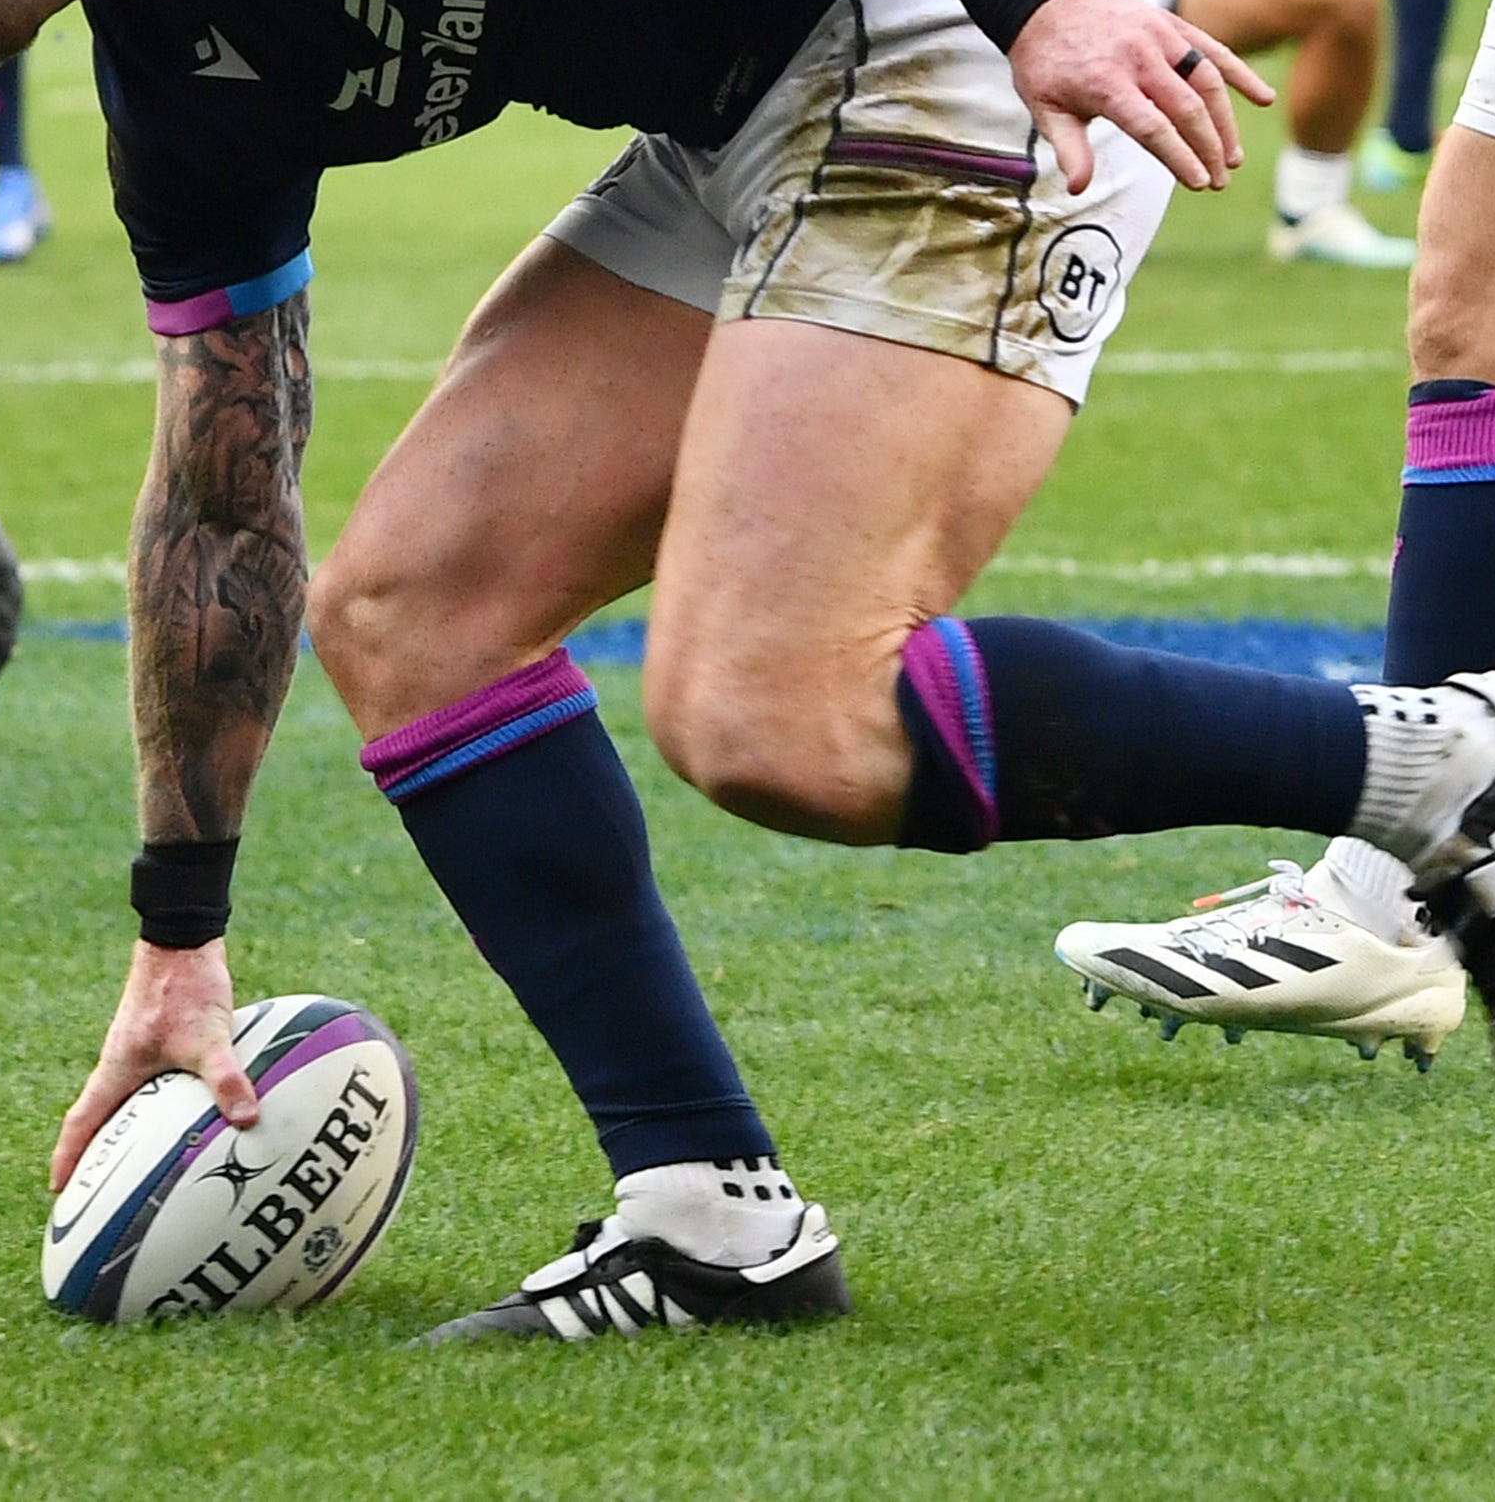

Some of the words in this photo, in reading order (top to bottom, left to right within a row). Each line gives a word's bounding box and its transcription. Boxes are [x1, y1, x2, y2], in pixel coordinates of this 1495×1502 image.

[414, 57, 472, 147] eter
[1059, 252, 1106, 312] BT
[145, 1064, 388, 1320] GILBERT
